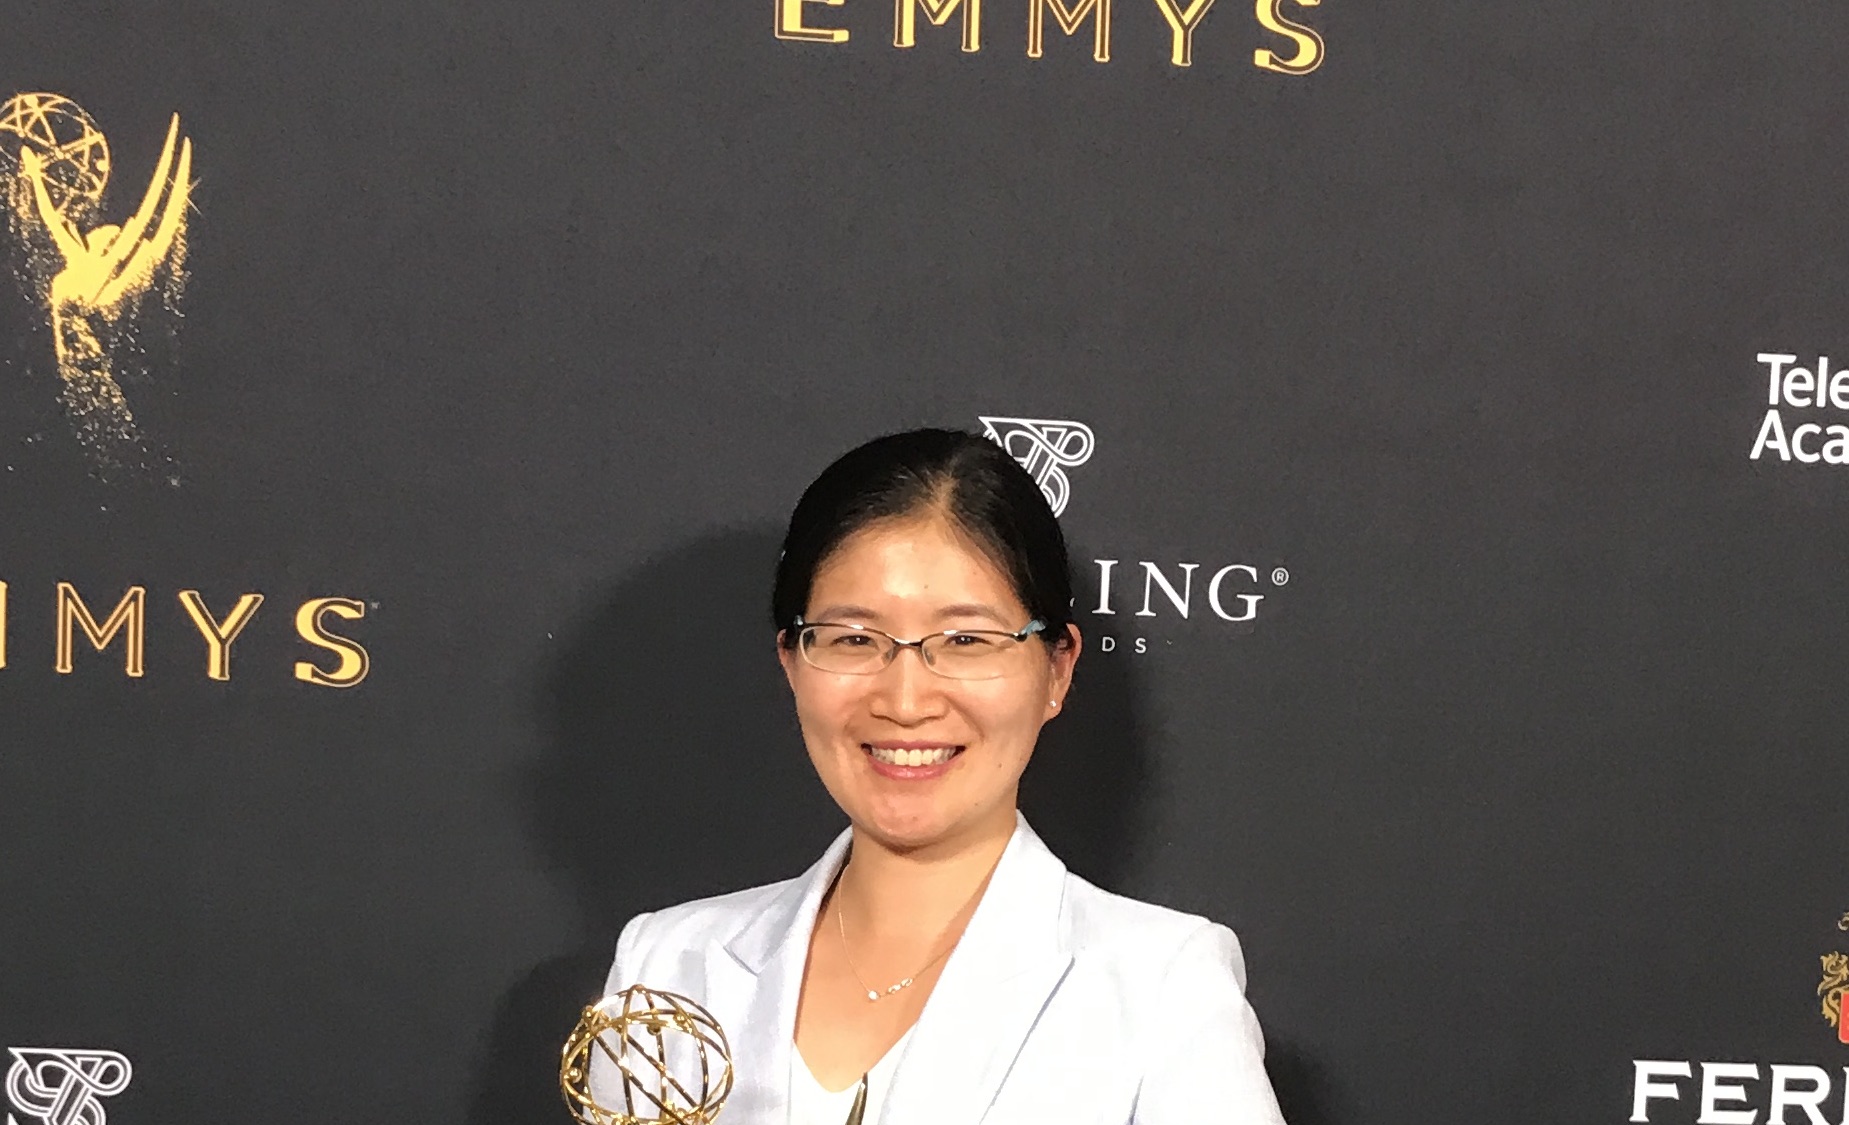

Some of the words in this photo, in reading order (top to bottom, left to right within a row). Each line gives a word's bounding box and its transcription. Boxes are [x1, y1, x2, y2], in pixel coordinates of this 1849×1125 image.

[773, 0, 1325, 75] EMMYS
[1756, 352, 1849, 409] Tele
[1749, 409, 1849, 465] Aca
[0, 581, 370, 688] MYS
